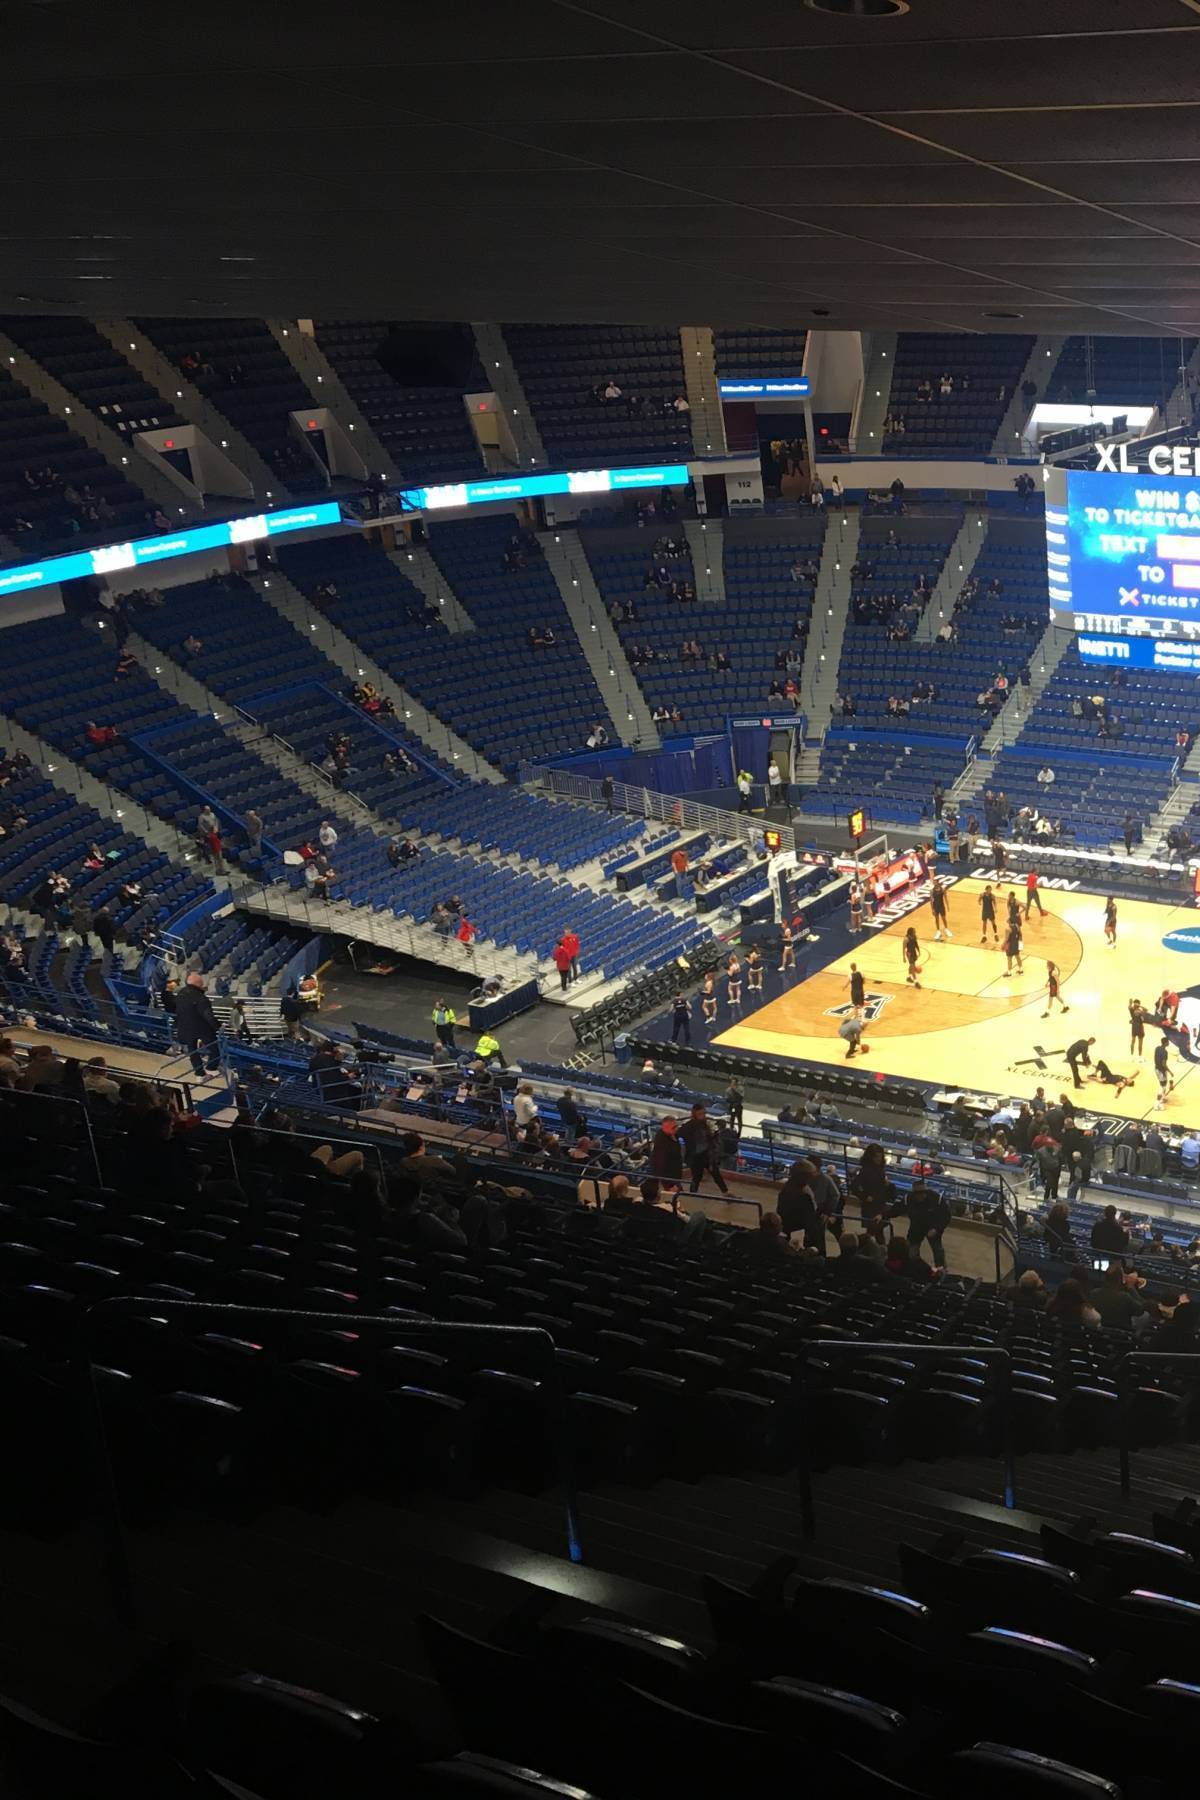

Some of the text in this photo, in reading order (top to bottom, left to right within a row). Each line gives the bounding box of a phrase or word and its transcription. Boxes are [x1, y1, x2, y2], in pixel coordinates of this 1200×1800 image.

[1095, 443, 1138, 473] XL
[1135, 489, 1179, 510] WIN
[1084, 507, 1109, 524] TO
[1101, 534, 1148, 553] TEXT
[1138, 565, 1165, 583] TO
[1141, 593, 1199, 608] TICKET
[970, 868, 1081, 891] UCONN
[1022, 1069, 1072, 1082] CENTER
